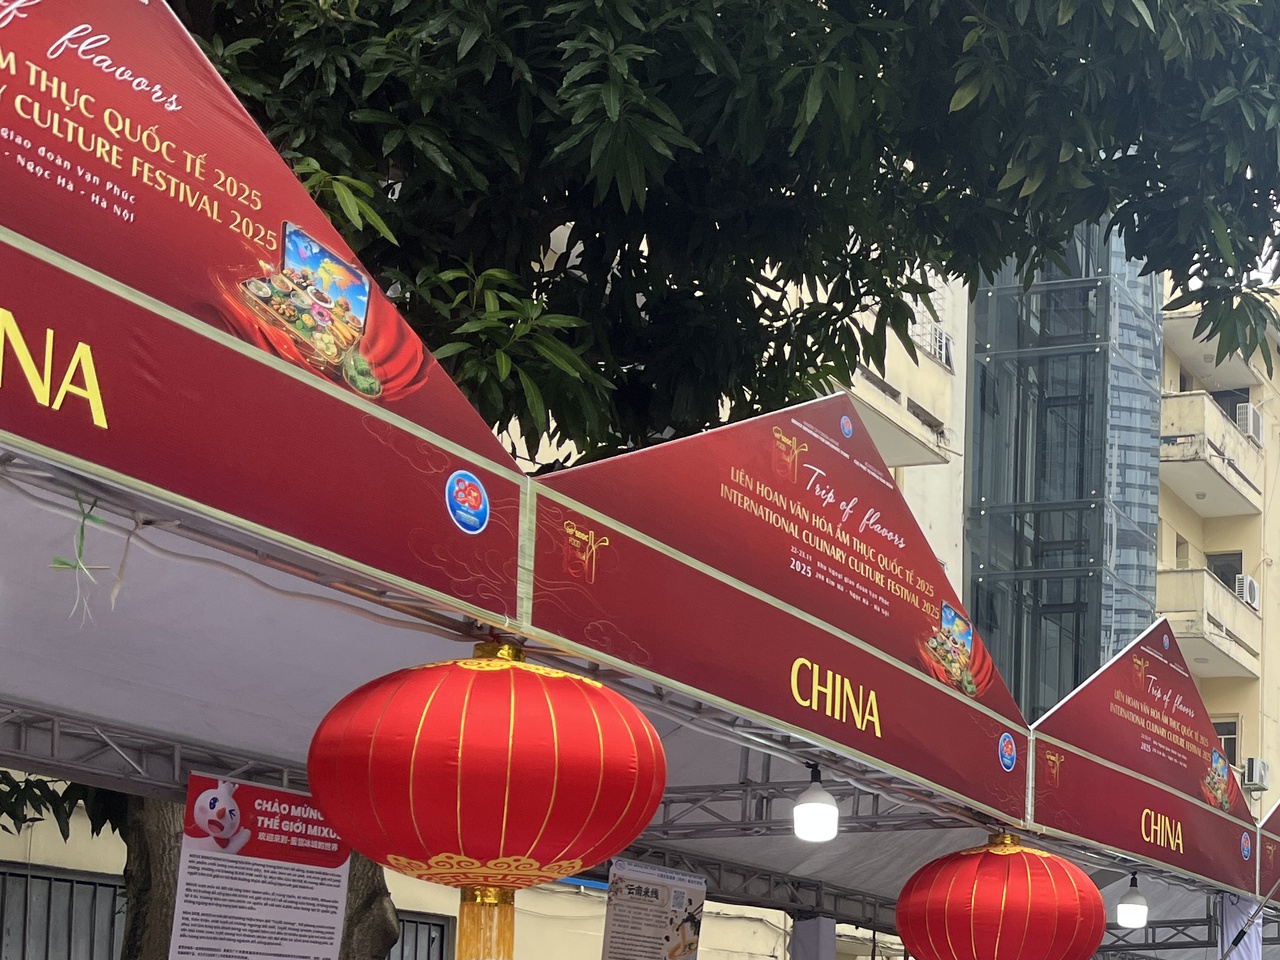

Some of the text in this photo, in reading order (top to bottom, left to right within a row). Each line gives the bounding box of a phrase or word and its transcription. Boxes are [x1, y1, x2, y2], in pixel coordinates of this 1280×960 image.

[47, 24, 182, 111] flavors
[14, 94, 277, 251] CULTURE FESTIVAL 2025
[25, 60, 96, 119] THỤC
[103, 108, 177, 164] QUỐC
[182, 150, 207, 181] TẾ
[213, 168, 262, 211] 2025
[730, 466, 754, 491] LIÊN
[756, 480, 787, 511] HOAN
[789, 499, 810, 523] VĂN
[811, 513, 833, 537] HÓA
[852, 536, 876, 562] THỤC
[877, 553, 904, 579] QUỐC
[916, 576, 934, 598] 2025
[803, 463, 836, 507] Trip
[839, 497, 858, 522] of
[858, 508, 906, 549] flavors
[720, 483, 940, 620] INTERNATIONAL CULINARY CULTURE FESTIVAL 2025
[789, 557, 812, 578] 2025
[790, 657, 882, 738] CHINA
[1146, 674, 1162, 702] Trip
[1172, 694, 1195, 719] flavors
[254, 798, 289, 815] CHÀO
[256, 813, 341, 840] THẾ GIỚI MIXU
[1141, 808, 1184, 854] CHINA
[627, 883, 660, 900] 云南米线
